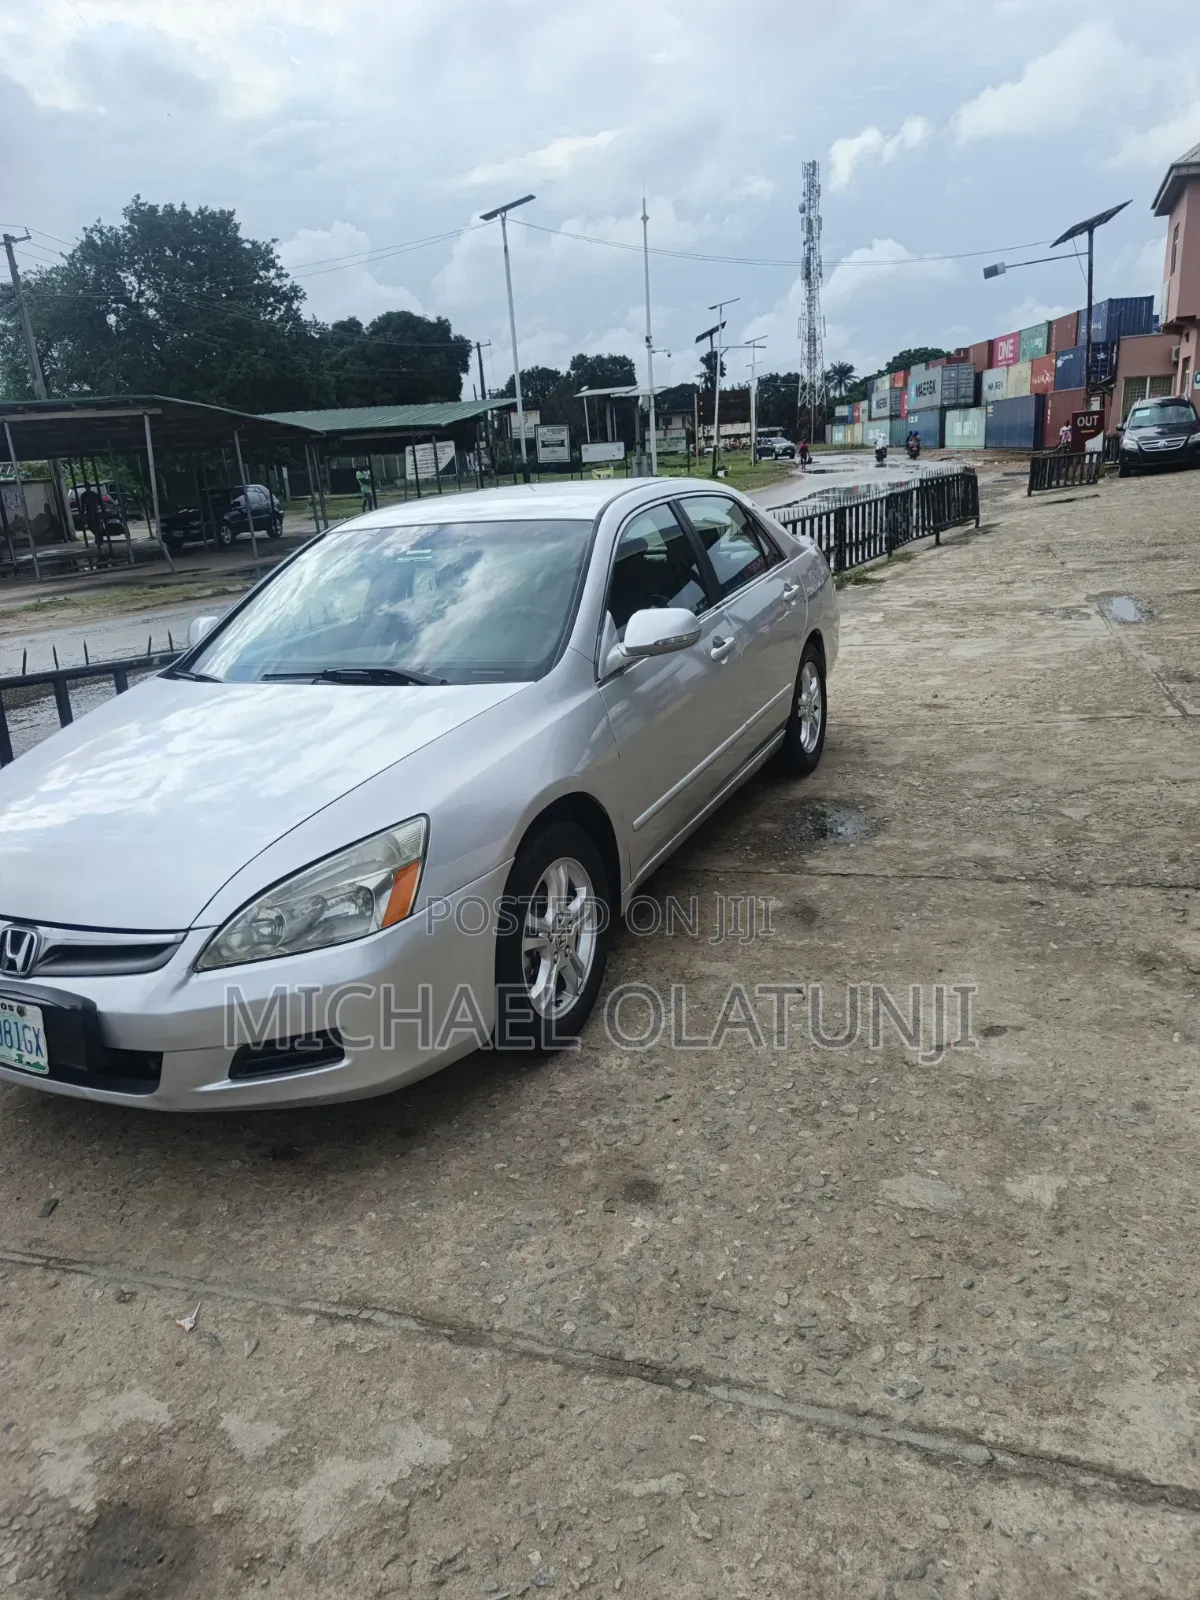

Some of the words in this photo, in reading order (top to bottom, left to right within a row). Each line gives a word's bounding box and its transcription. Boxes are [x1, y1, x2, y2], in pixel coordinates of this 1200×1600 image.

[998, 338, 1015, 361] ONE
[1077, 415, 1099, 427] OUT
[0, 1019, 44, 1059] 81GX
